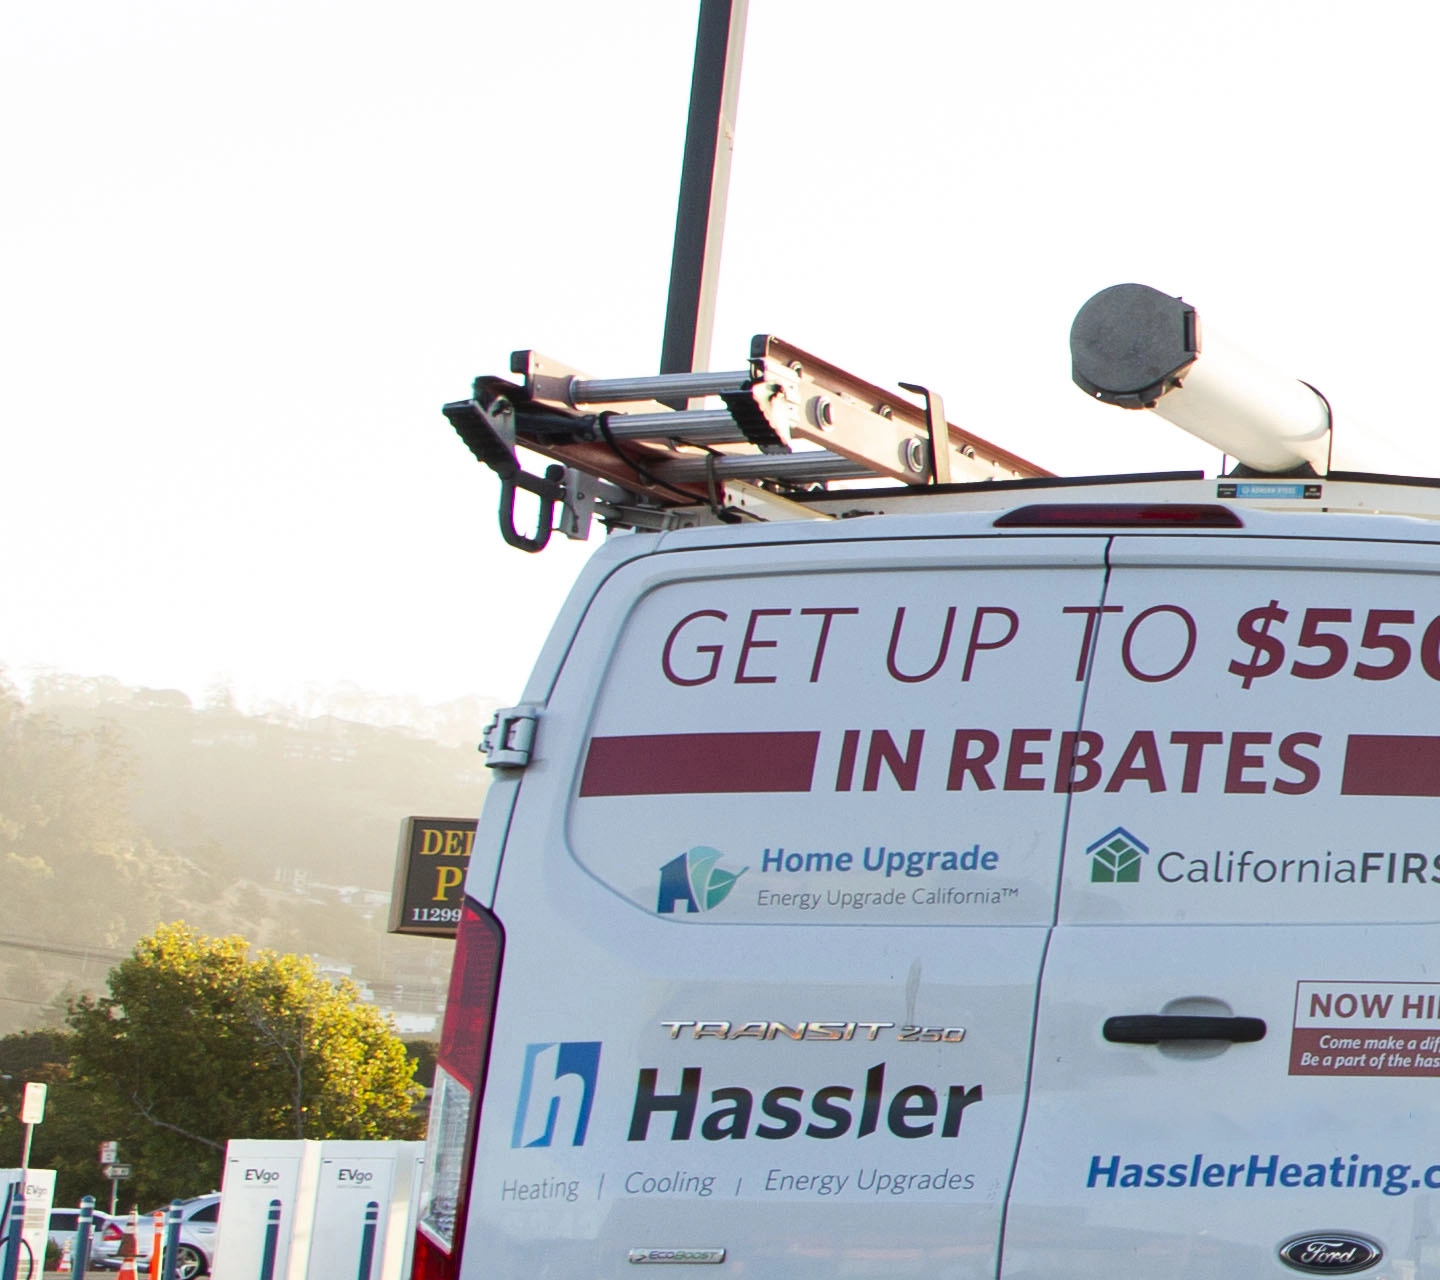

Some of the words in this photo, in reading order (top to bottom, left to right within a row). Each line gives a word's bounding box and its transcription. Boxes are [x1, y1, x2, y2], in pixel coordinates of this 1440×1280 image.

[661, 606, 860, 687] GET
[886, 605, 1019, 684] UP
[1061, 604, 1198, 683] TO
[834, 728, 926, 793] IN
[946, 728, 1323, 796] REBATES
[761, 845, 853, 873] Home
[862, 844, 1000, 880] Upgrade
[757, 887, 821, 912] Energy
[826, 887, 907, 912] Upgrade
[411, 907, 462, 922] 11299
[1308, 993, 1395, 1021] NOW
[660, 1020, 895, 1043] TRANSIT
[896, 1025, 968, 1044] 250
[1319, 1033, 1361, 1051] Come
[1363, 1033, 1405, 1052] make
[1407, 1038, 1418, 1052] a
[1300, 1052, 1320, 1069] Be
[1321, 1056, 1333, 1069] a
[1334, 1052, 1367, 1071] part
[1368, 1052, 1386, 1072] of
[1387, 1052, 1412, 1070] the
[627, 1061, 983, 1142] Hassler
[245, 1168, 280, 1184] EVgo
[338, 1168, 373, 1184] EVgo
[501, 1177, 580, 1203] Heating
[625, 1170, 716, 1196] Cooling
[764, 1169, 849, 1196] Energy
[856, 1168, 976, 1194] Upgrades
[1300, 1241, 1356, 1266] Ford
